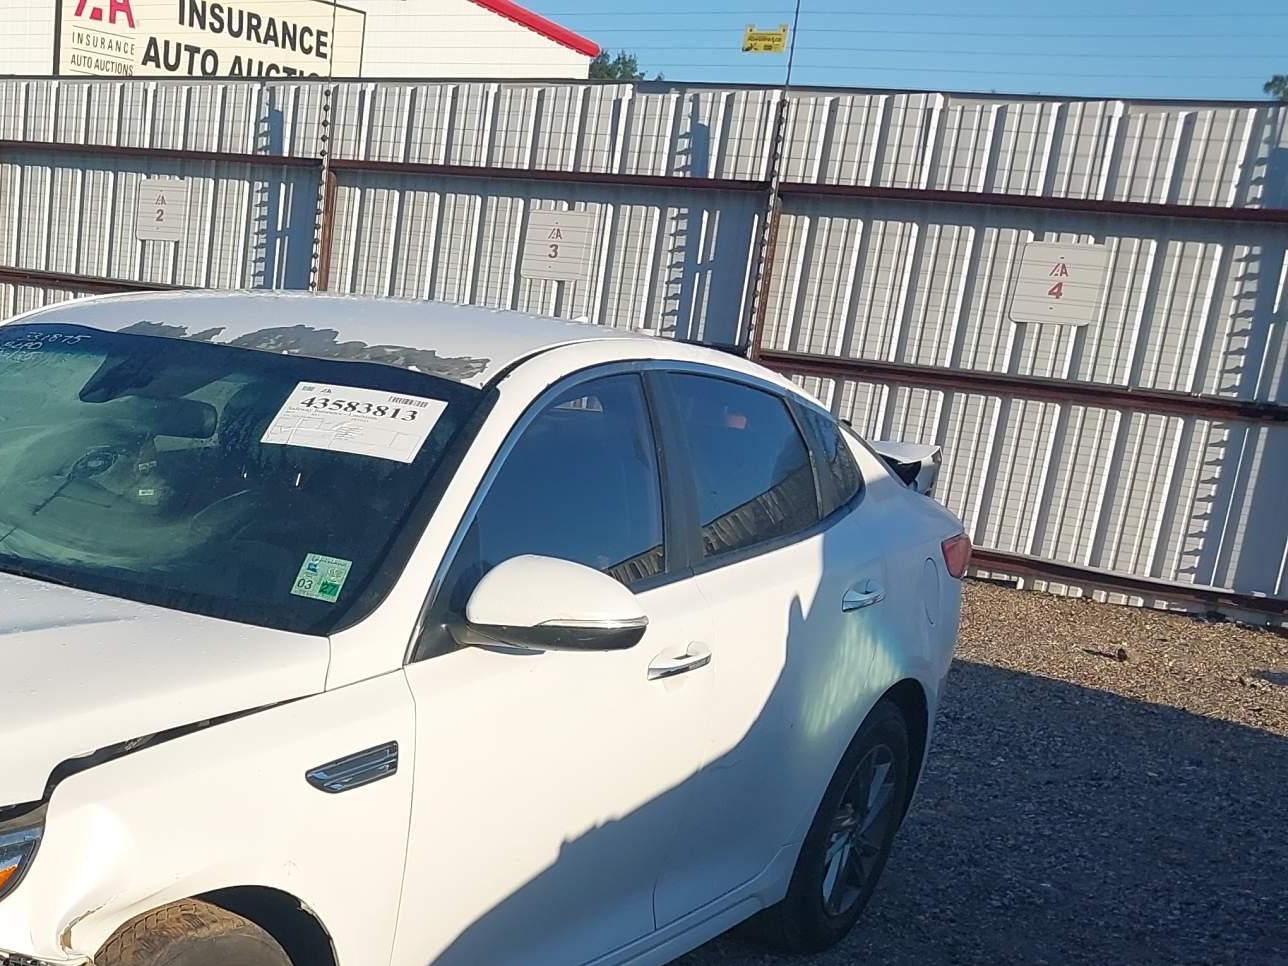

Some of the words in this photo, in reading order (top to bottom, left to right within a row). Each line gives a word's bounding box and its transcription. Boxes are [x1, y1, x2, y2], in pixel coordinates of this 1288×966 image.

[178, 0, 329, 59] INSURANCE
[72, 31, 136, 56] INSURANCE
[71, 54, 93, 69] AUTO
[94, 58, 134, 77] AUCTIONS
[141, 36, 219, 77] AUTO
[155, 209, 164, 222] 2
[548, 244, 559, 258] 3
[1048, 282, 1063, 299] 4
[300, 396, 418, 422] 43583813
[297, 578, 313, 590] 03
[319, 583, 337, 595] 27
